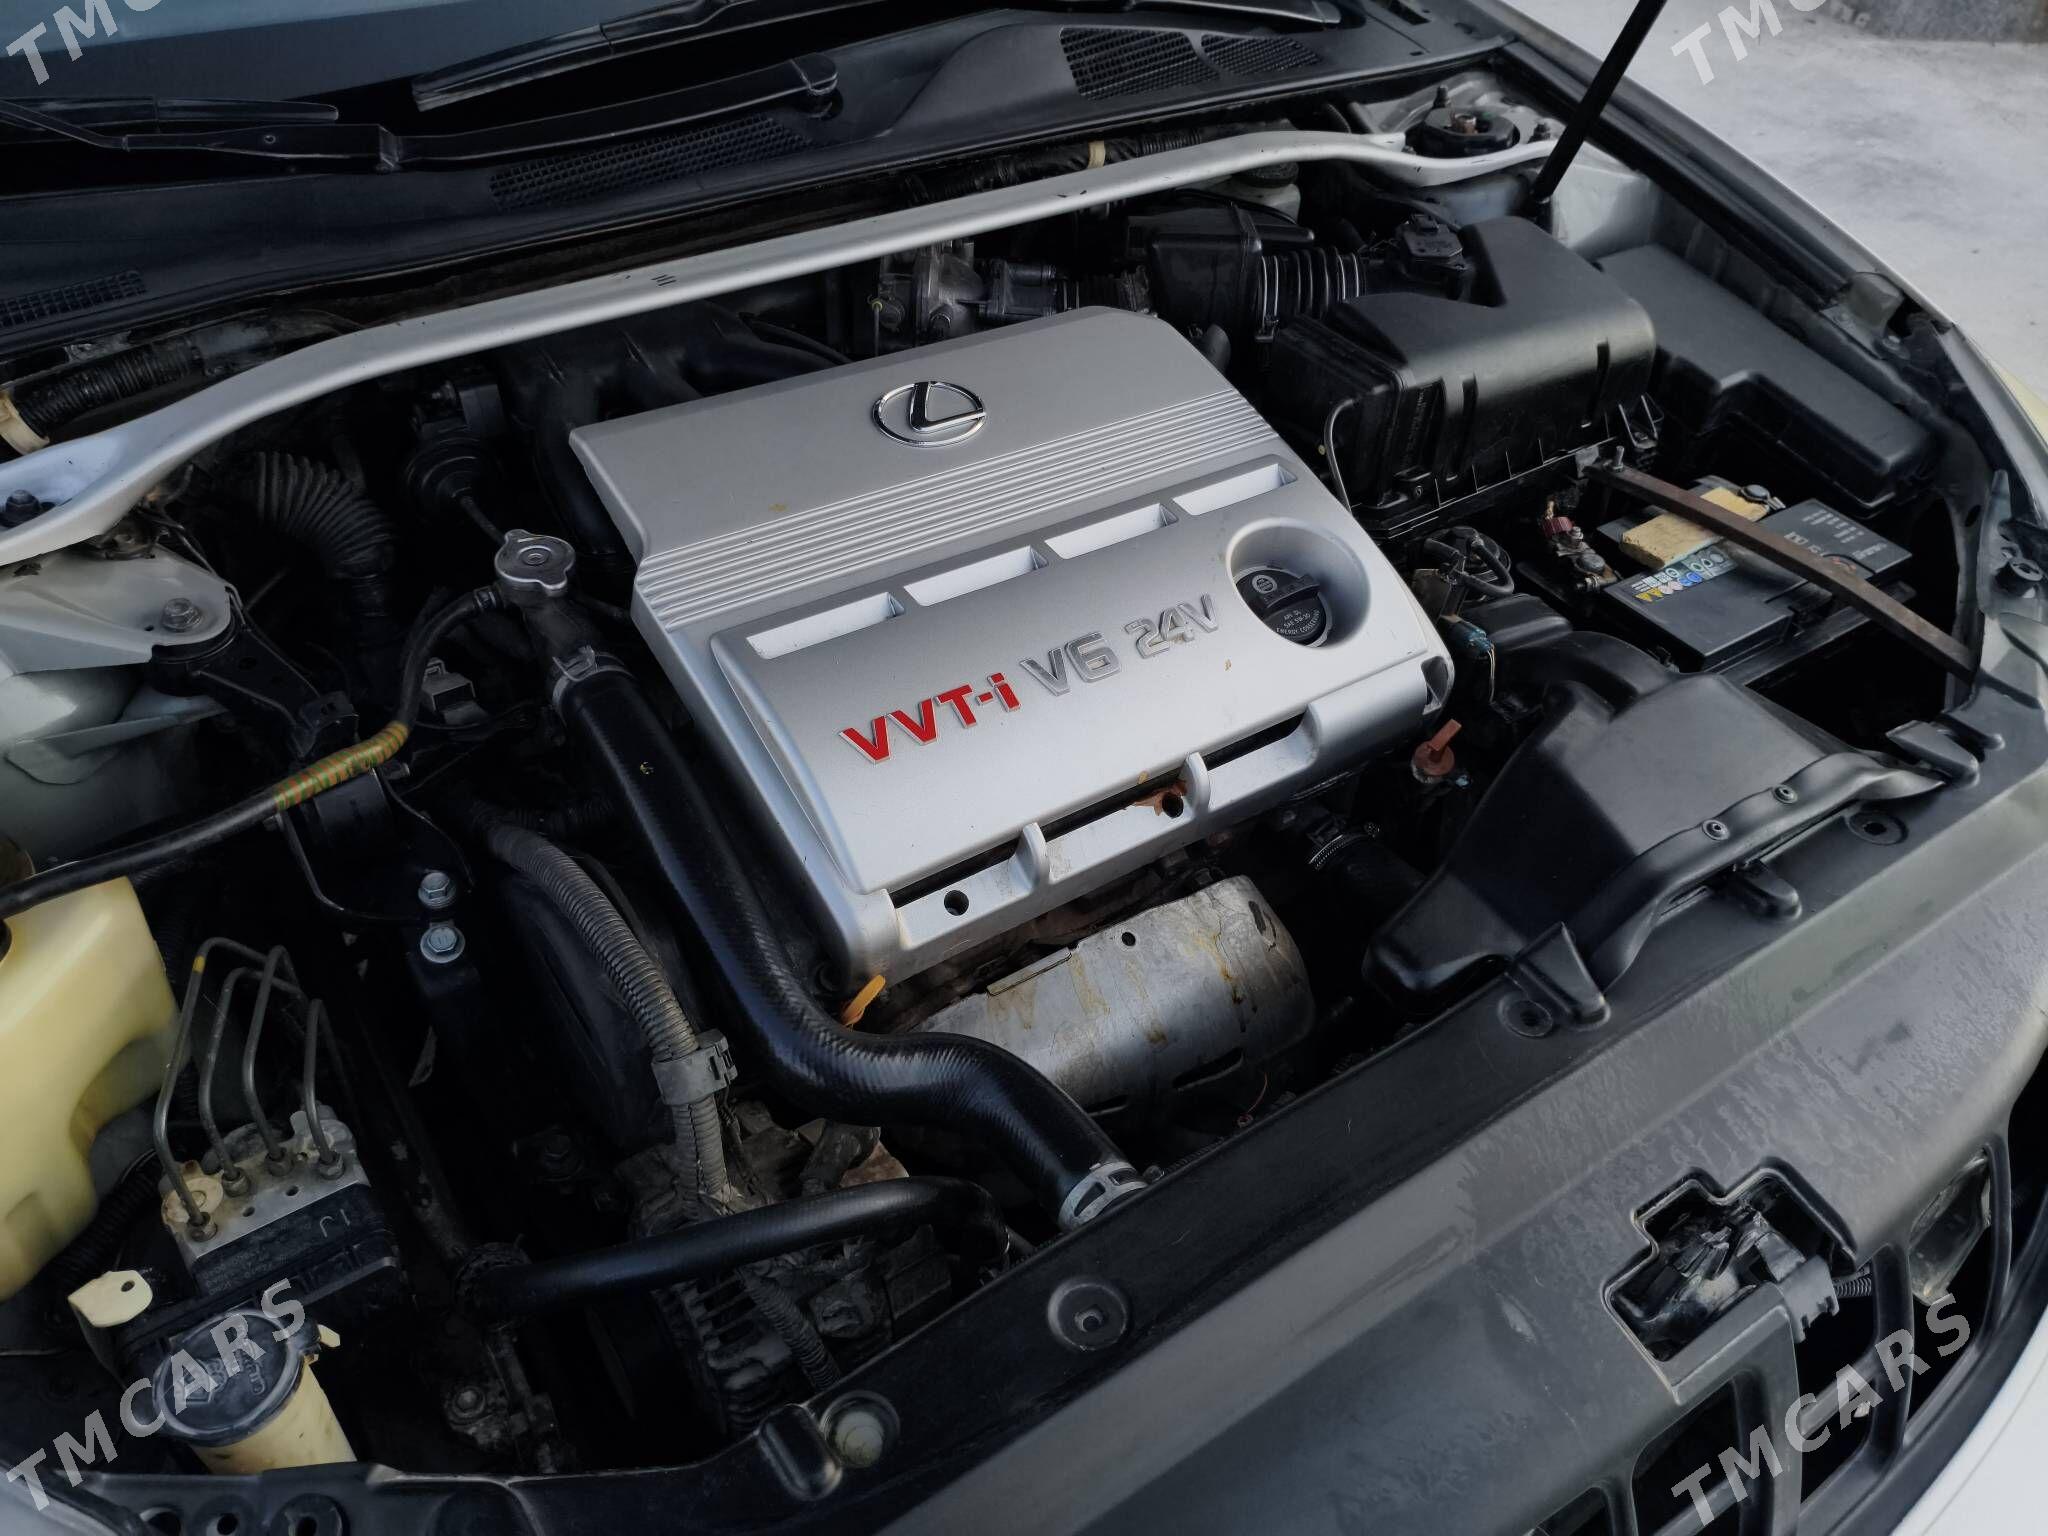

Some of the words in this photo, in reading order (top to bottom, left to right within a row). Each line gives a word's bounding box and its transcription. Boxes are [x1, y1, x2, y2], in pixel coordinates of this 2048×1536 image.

[838, 672, 1021, 764] VVT-i
[1019, 631, 1121, 697] V6
[1124, 593, 1219, 659] 24V
